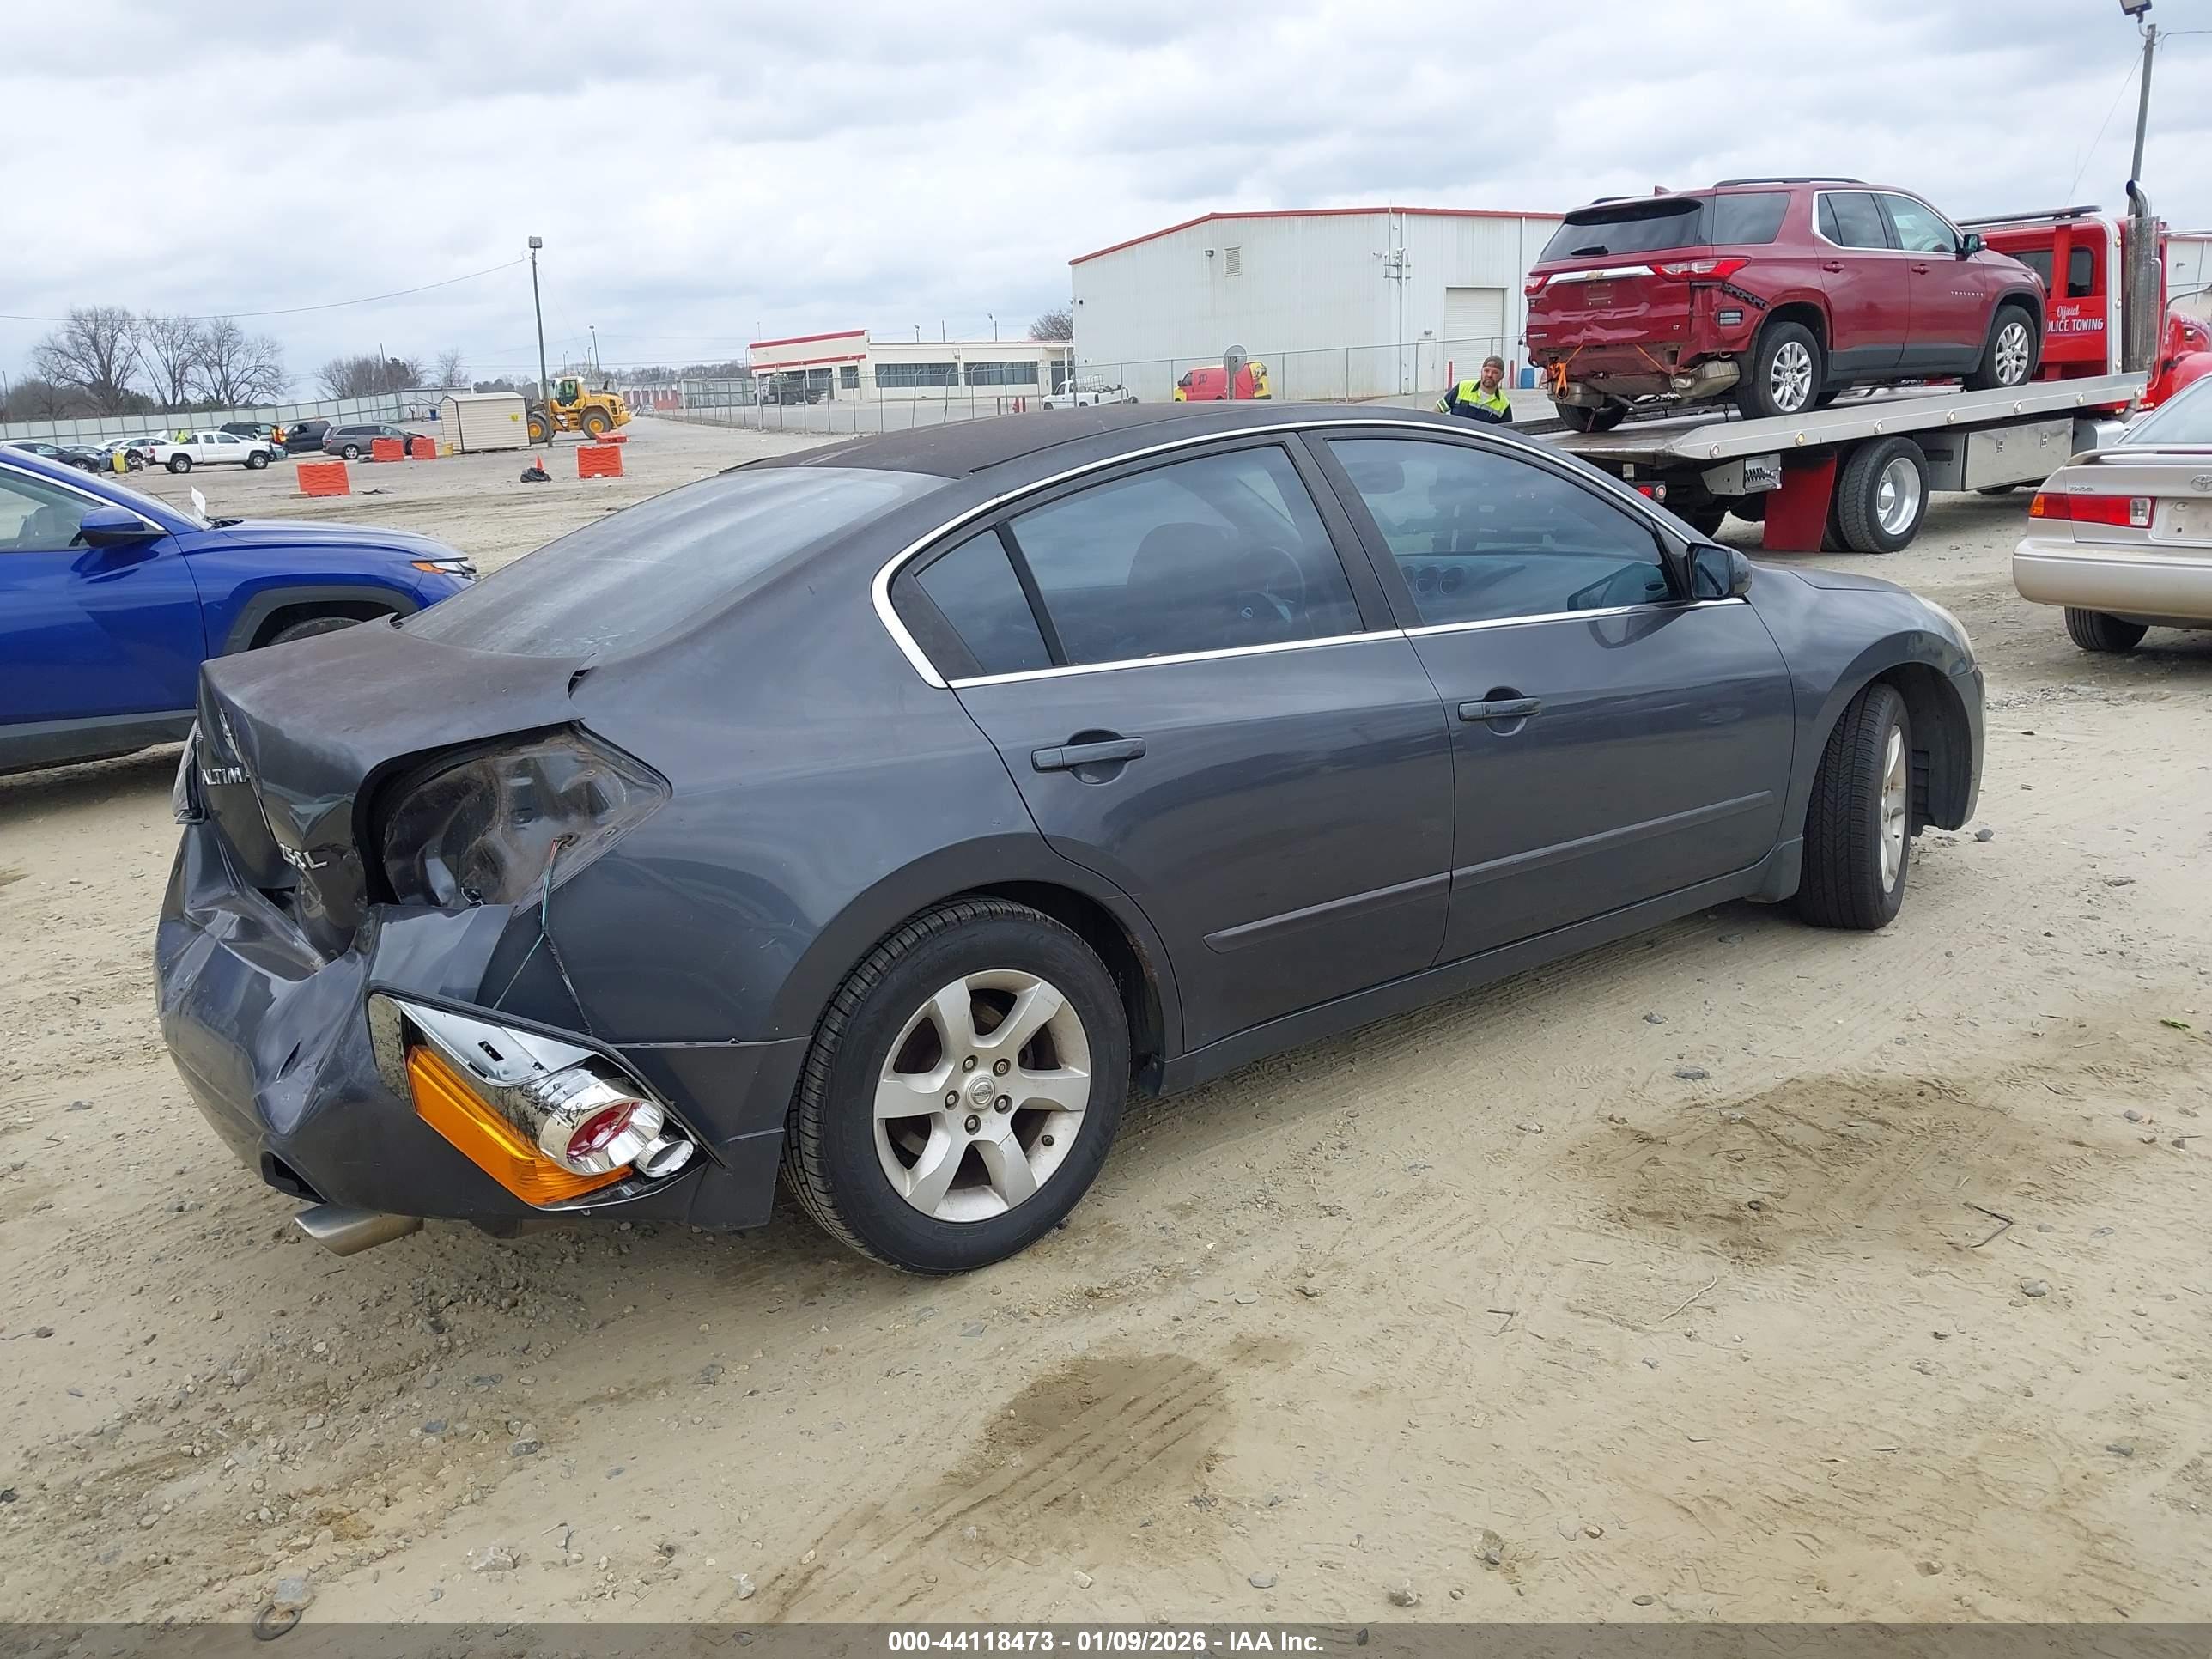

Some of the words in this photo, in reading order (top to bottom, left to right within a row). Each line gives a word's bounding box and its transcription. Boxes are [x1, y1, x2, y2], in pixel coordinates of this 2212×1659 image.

[2057, 304, 2080, 320] Official
[2047, 319, 2069, 333] OLICE
[2071, 318, 2104, 331] TOWING
